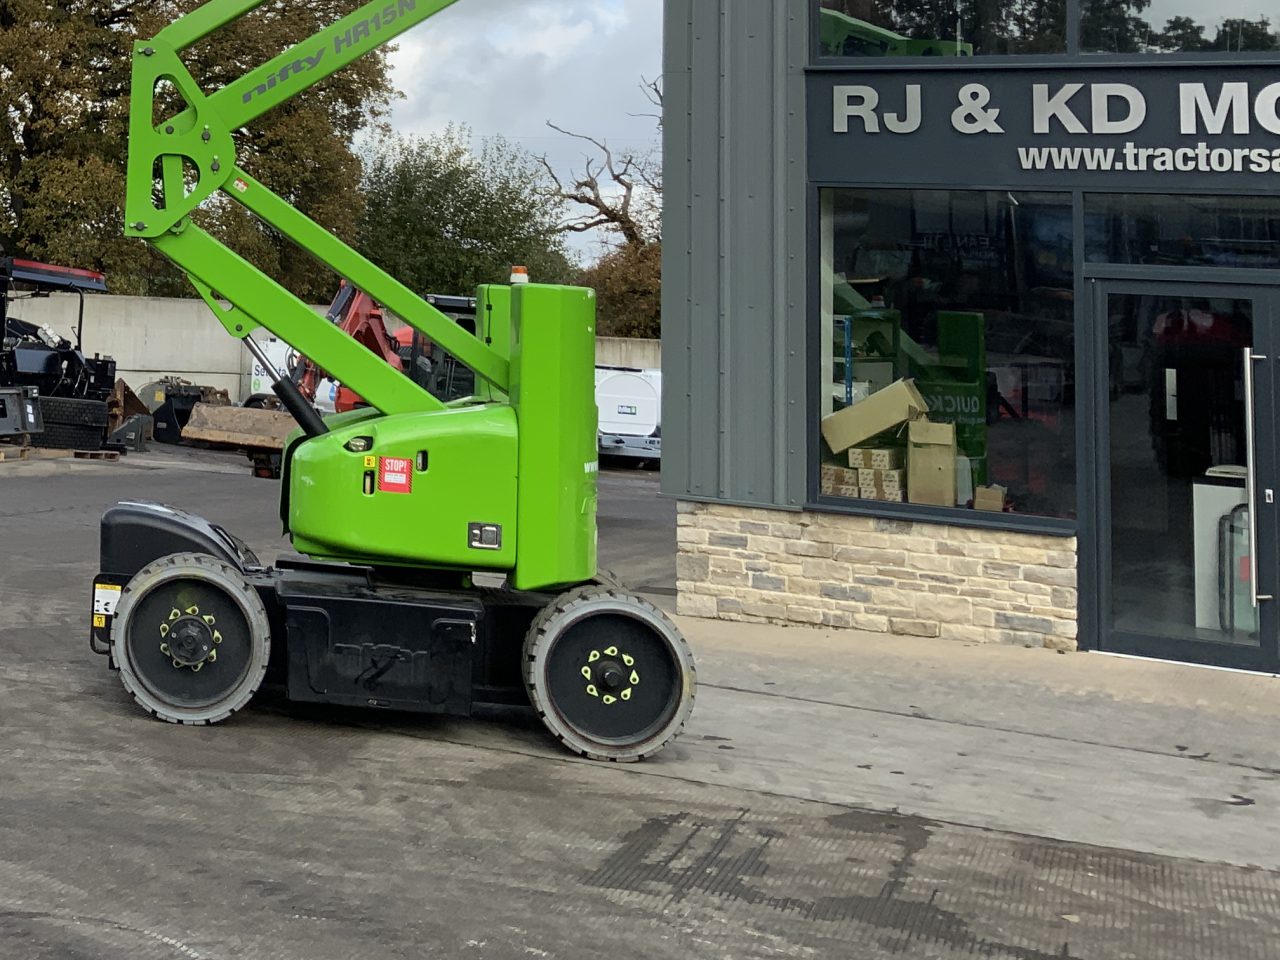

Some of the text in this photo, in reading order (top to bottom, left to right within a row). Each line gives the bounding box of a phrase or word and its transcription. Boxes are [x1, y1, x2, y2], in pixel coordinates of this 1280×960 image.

[242, 46, 327, 104] nifty
[833, 84, 922, 134] RJ
[950, 83, 1006, 135] &
[1032, 83, 1147, 135] KD
[384, 458, 407, 473] STOP!
